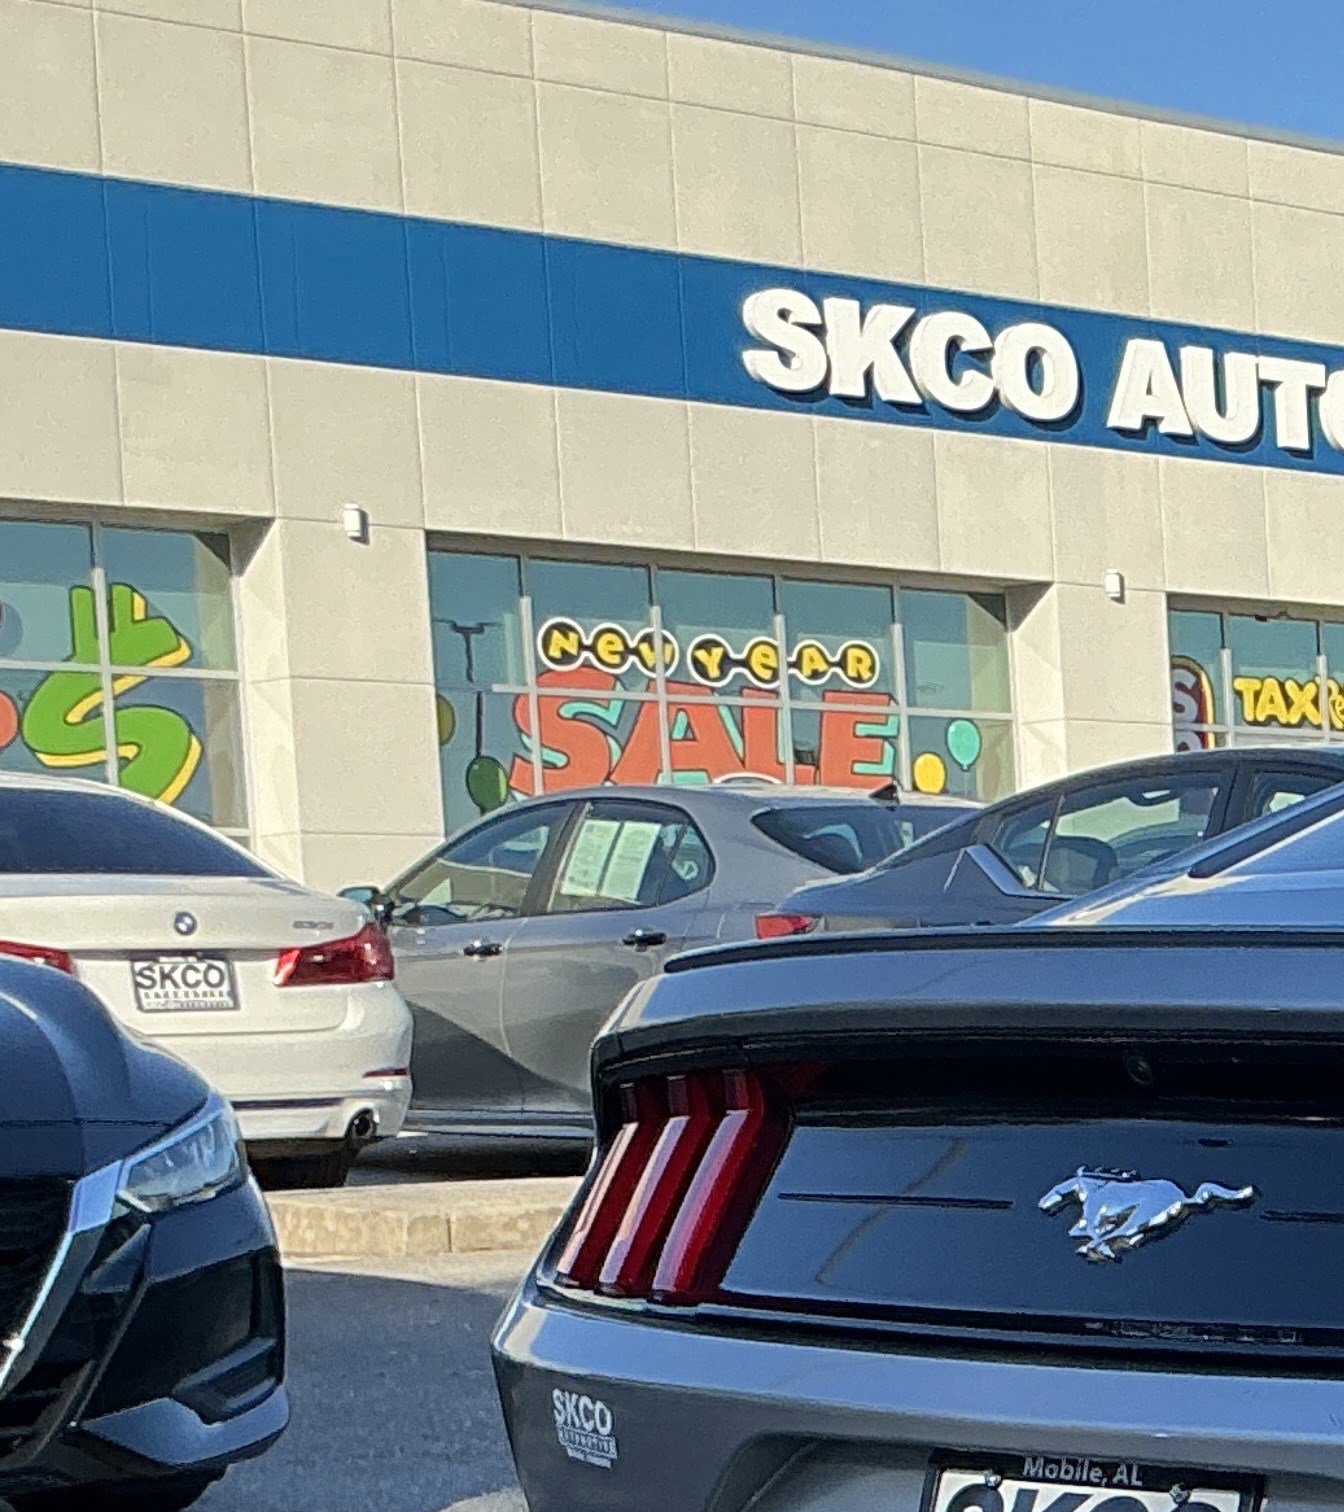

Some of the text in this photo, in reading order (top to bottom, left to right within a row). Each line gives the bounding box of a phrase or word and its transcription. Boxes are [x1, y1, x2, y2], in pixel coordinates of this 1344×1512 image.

[742, 288, 1078, 422] SKCO
[1233, 677, 1323, 726] TAX
[508, 665, 896, 796] SALE
[135, 963, 225, 990] SKCO
[552, 1388, 612, 1436] SKCO
[1023, 1457, 1143, 1487] Mobile, AL
